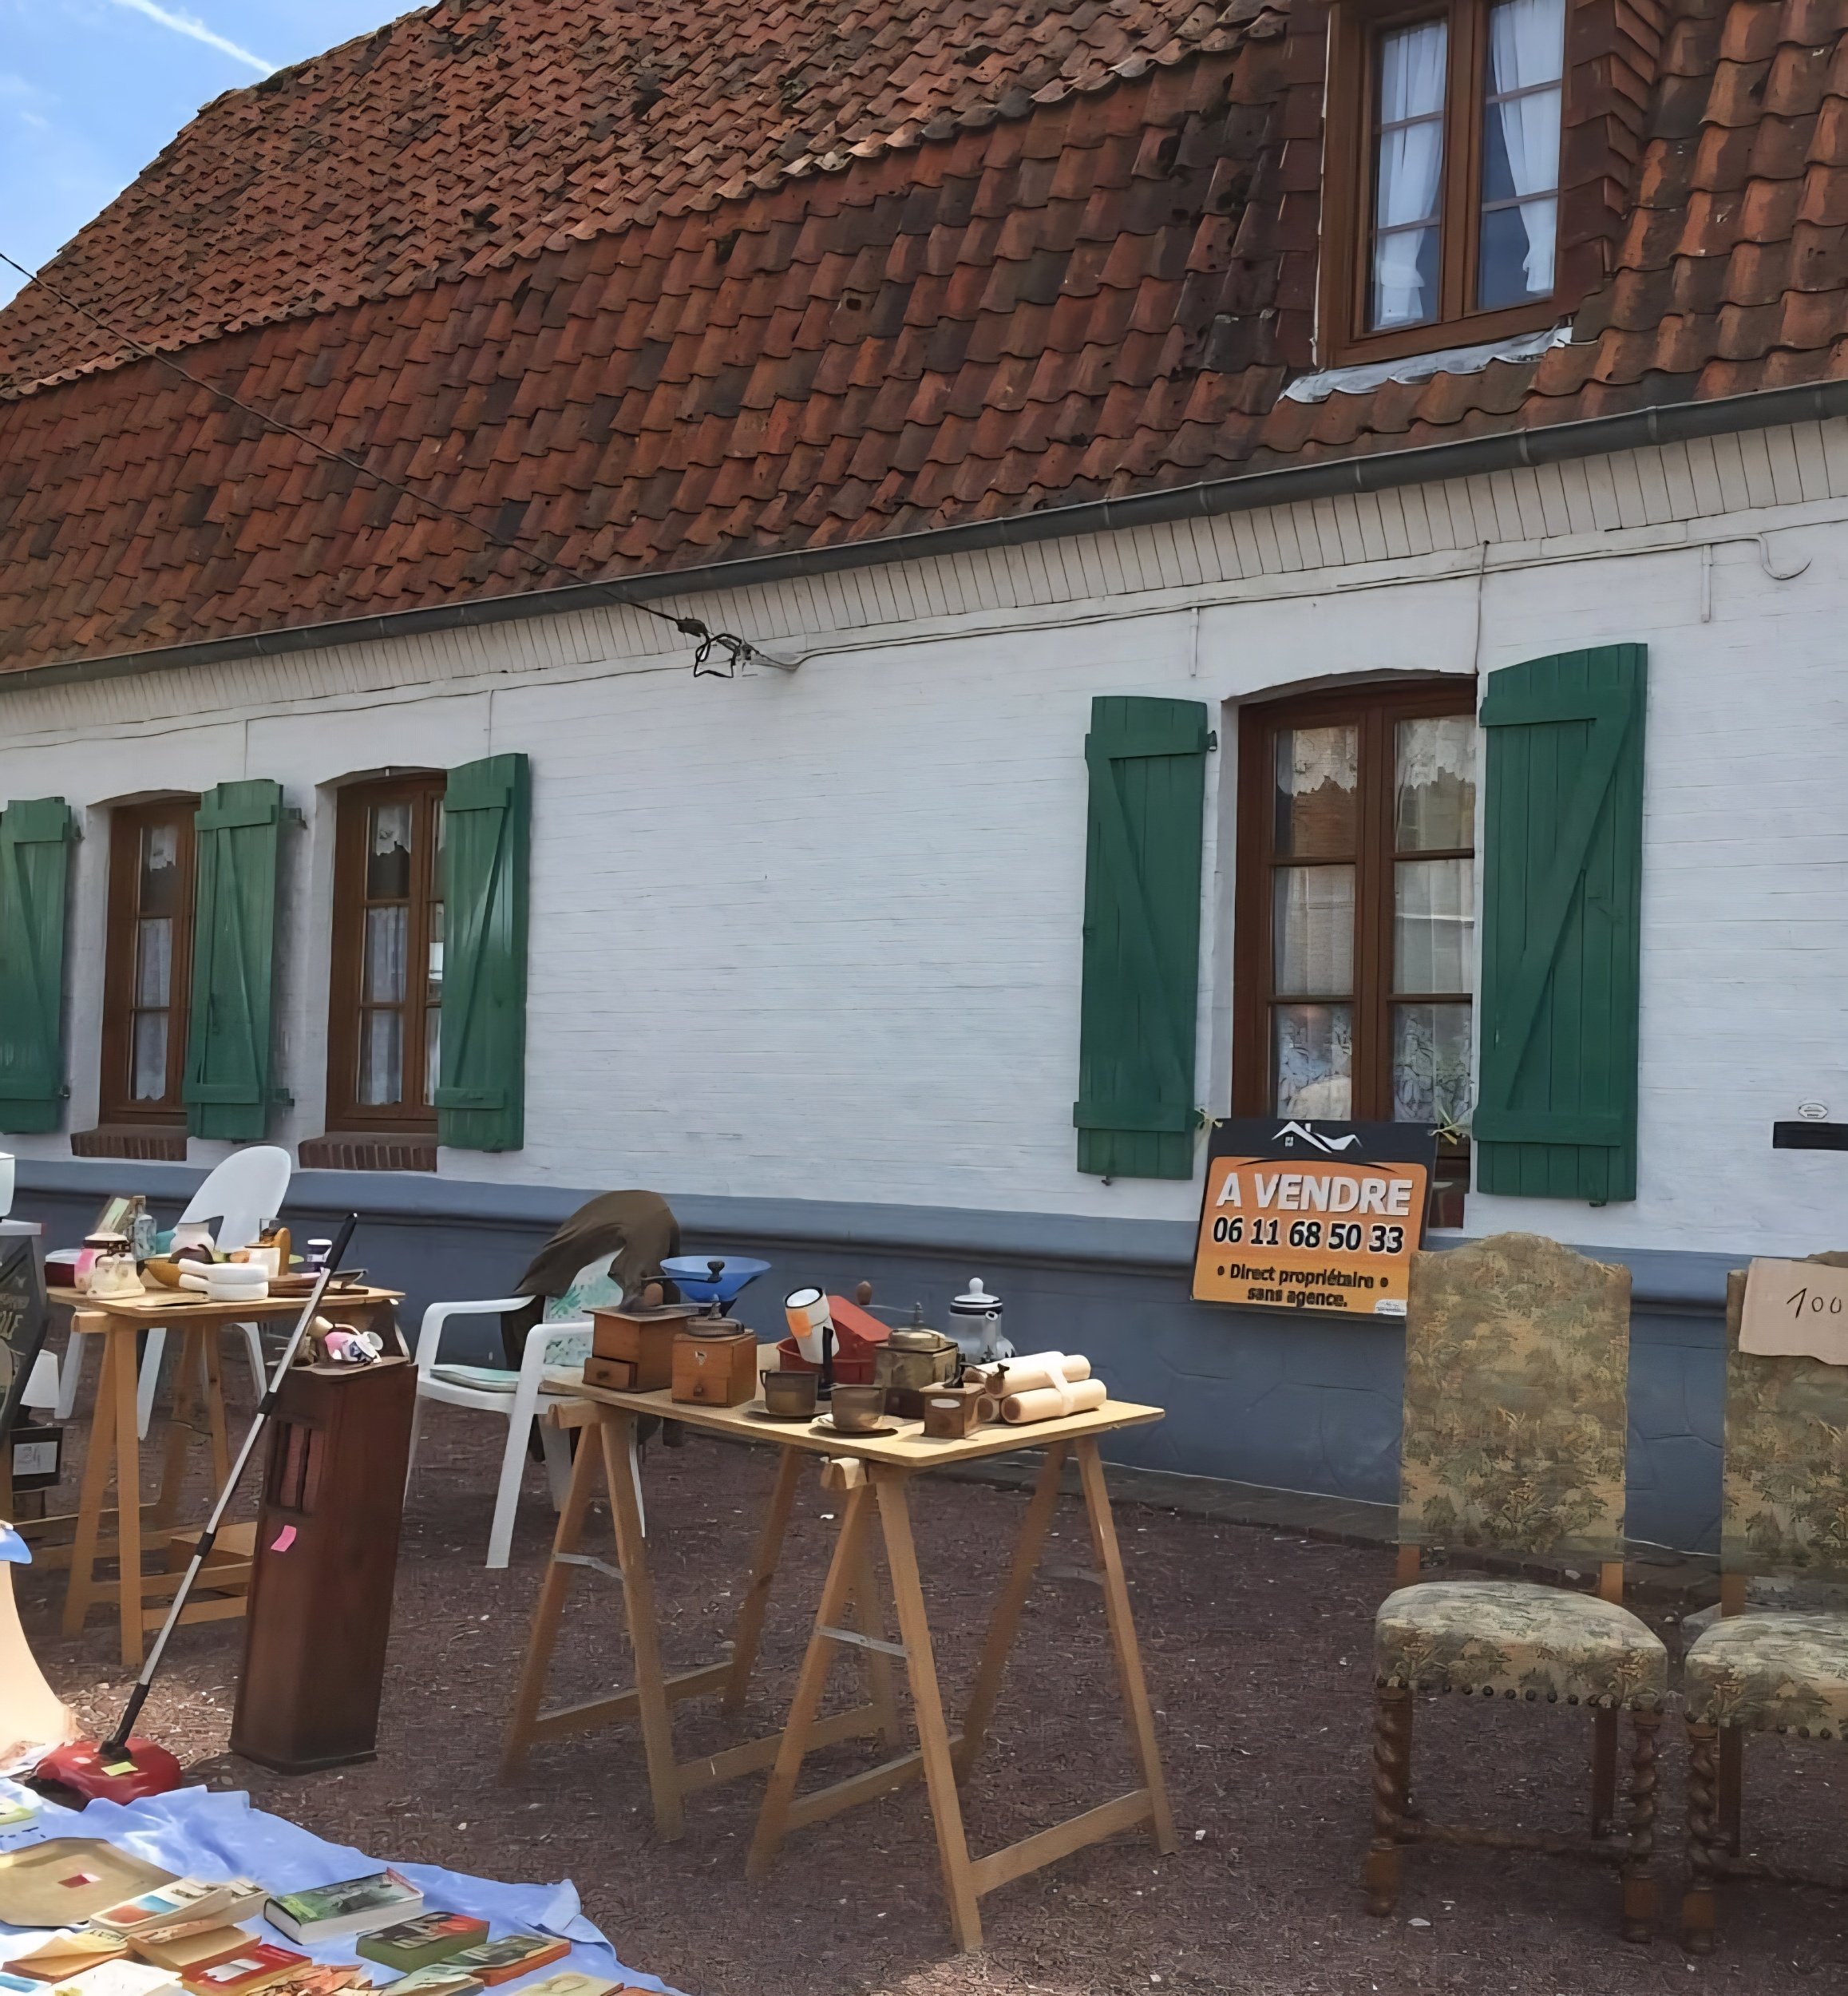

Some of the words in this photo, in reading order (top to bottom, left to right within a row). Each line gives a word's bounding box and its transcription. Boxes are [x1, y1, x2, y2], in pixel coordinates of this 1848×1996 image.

[1216, 1172, 1242, 1207] A
[1254, 1173, 1413, 1216] VENDRE
[1213, 1216, 1243, 1243] 06
[1251, 1218, 1279, 1245] 11
[1288, 1220, 1322, 1248] 68
[1328, 1222, 1362, 1251] 50
[1368, 1225, 1404, 1254] 33
[1230, 1263, 1276, 1281] Direct
[1279, 1268, 1374, 1289] propriétaire
[1247, 1286, 1283, 1301] sans
[1287, 1289, 1347, 1308] agence.
[1786, 1287, 1842, 1319] 100
